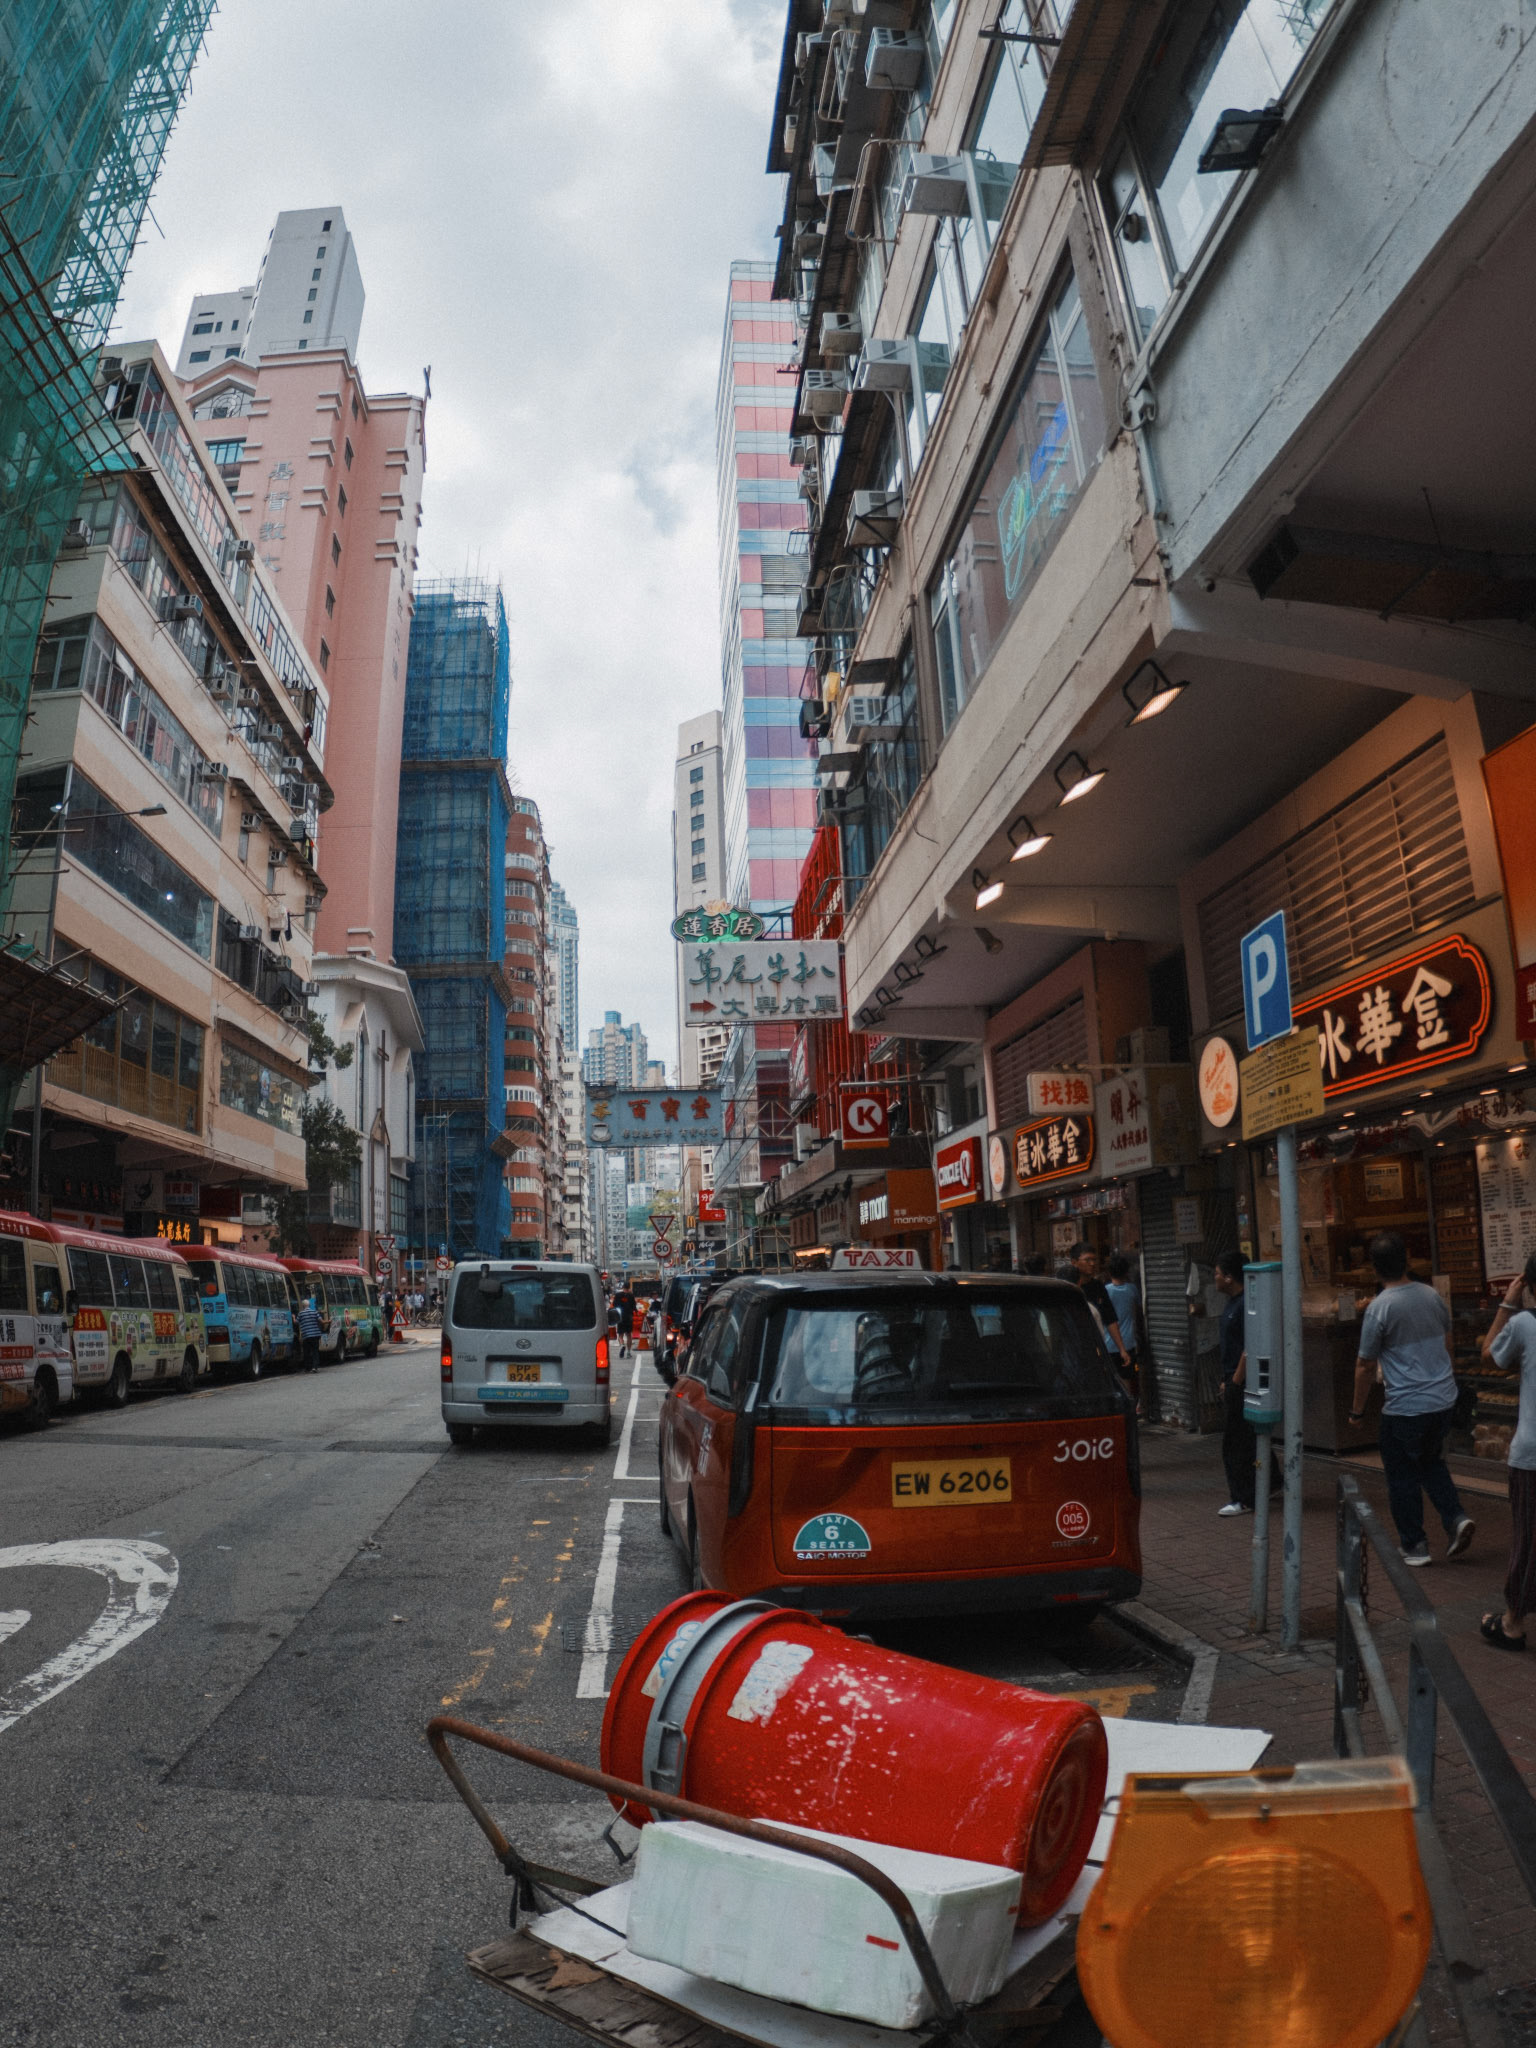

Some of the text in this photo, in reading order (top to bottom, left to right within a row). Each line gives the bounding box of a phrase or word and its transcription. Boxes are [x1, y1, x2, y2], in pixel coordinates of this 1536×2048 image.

[682, 916, 756, 938] 蓮香居
[1248, 933, 1277, 1037] P
[1040, 1079, 1089, 1106] 找換
[857, 1106, 878, 1132] K
[938, 1160, 961, 1187] CIRCLE
[893, 1215, 938, 1225] mannings
[656, 1244, 669, 1253] 50
[843, 1250, 914, 1267] TAXI
[379, 1261, 392, 1270] 50
[516, 1364, 531, 1373] PP
[509, 1373, 538, 1382] 8245
[895, 1469, 1009, 1496] EW 6206
[816, 1516, 848, 1526] TAXI
[1062, 1512, 1084, 1525] 005
[824, 1525, 839, 1540] 6
[809, 1541, 855, 1549] SEATS
[796, 1551, 867, 1560] SAIC MOTOR
